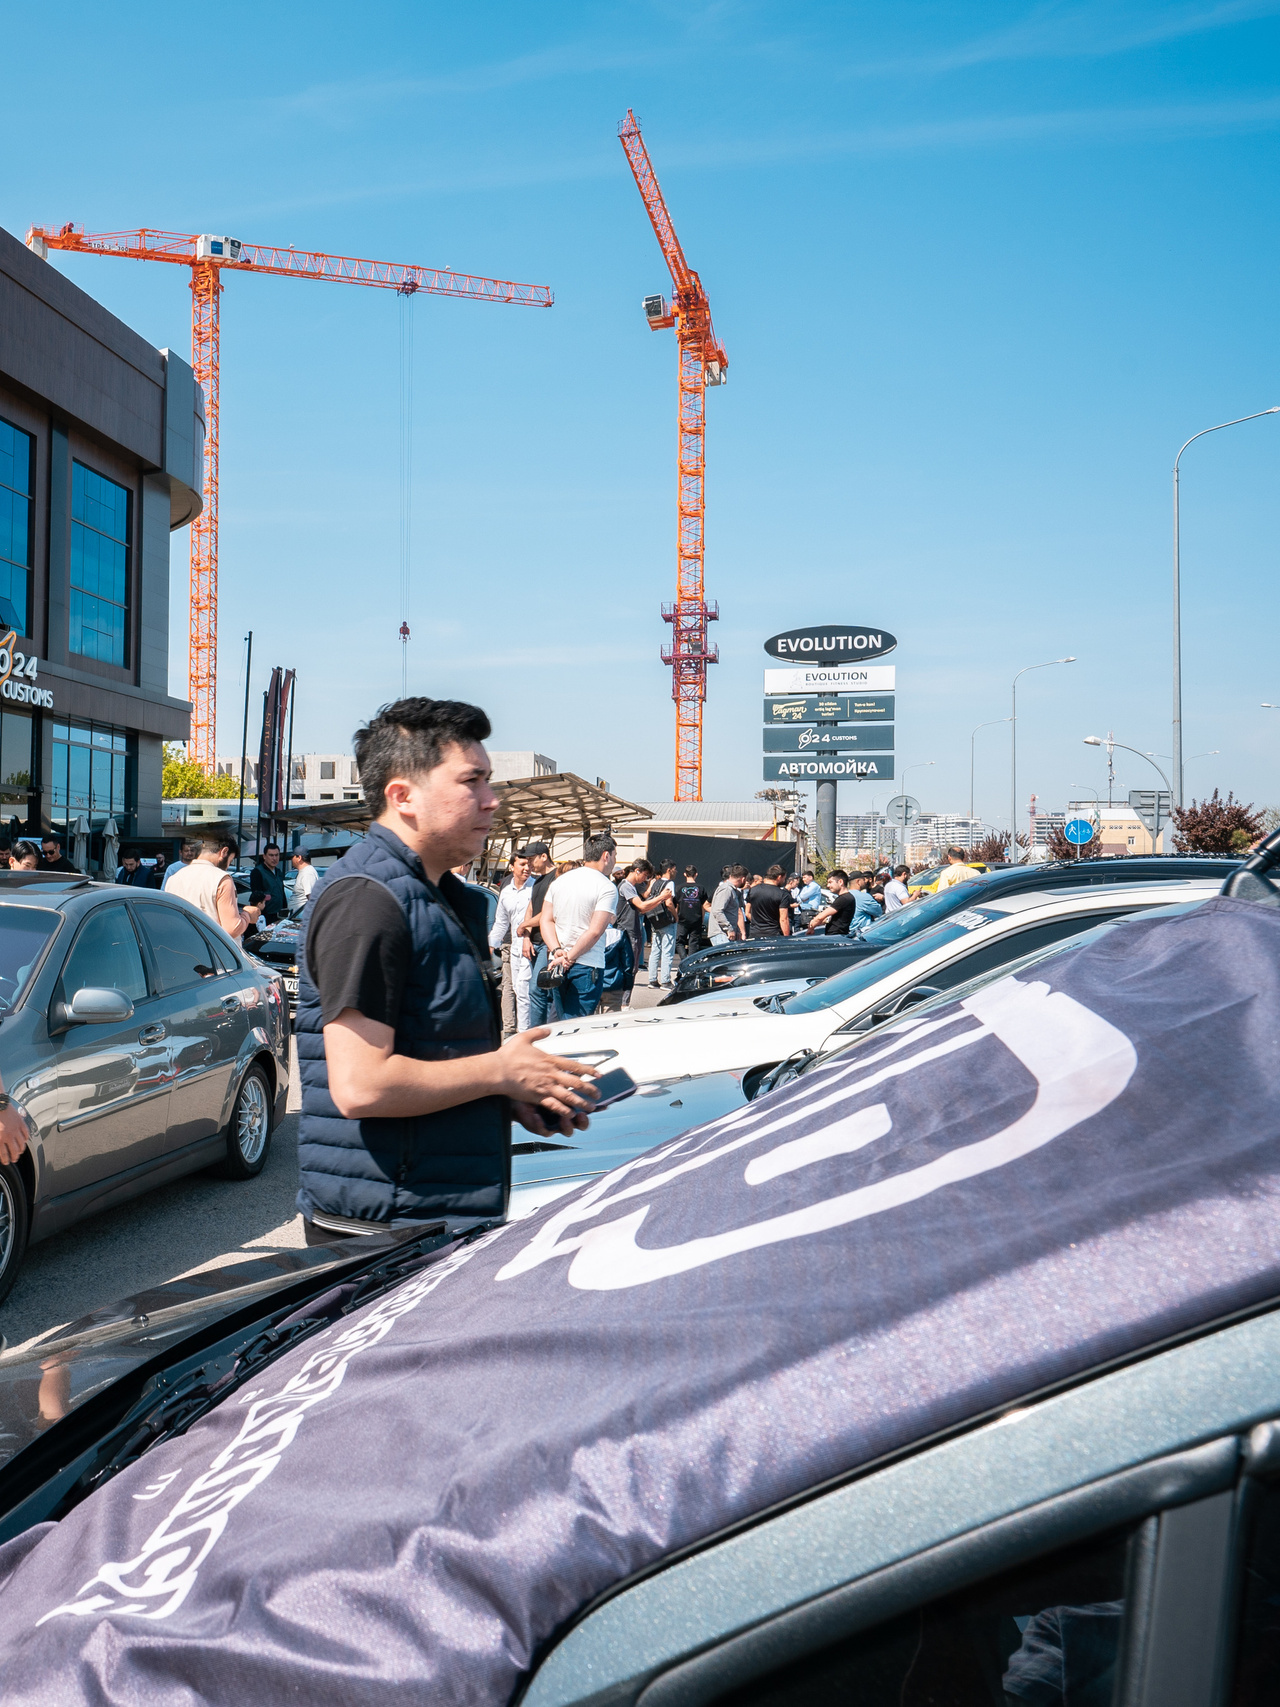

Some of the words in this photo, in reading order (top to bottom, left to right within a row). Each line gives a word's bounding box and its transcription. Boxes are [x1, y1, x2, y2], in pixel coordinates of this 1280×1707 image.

[777, 634, 883, 653] EVOLUTION
[805, 671, 868, 681] EVOLUTION
[1, 679, 54, 709] CUSTOMS
[792, 712, 803, 720] 24
[778, 759, 879, 775] АВТОМОЙКА
